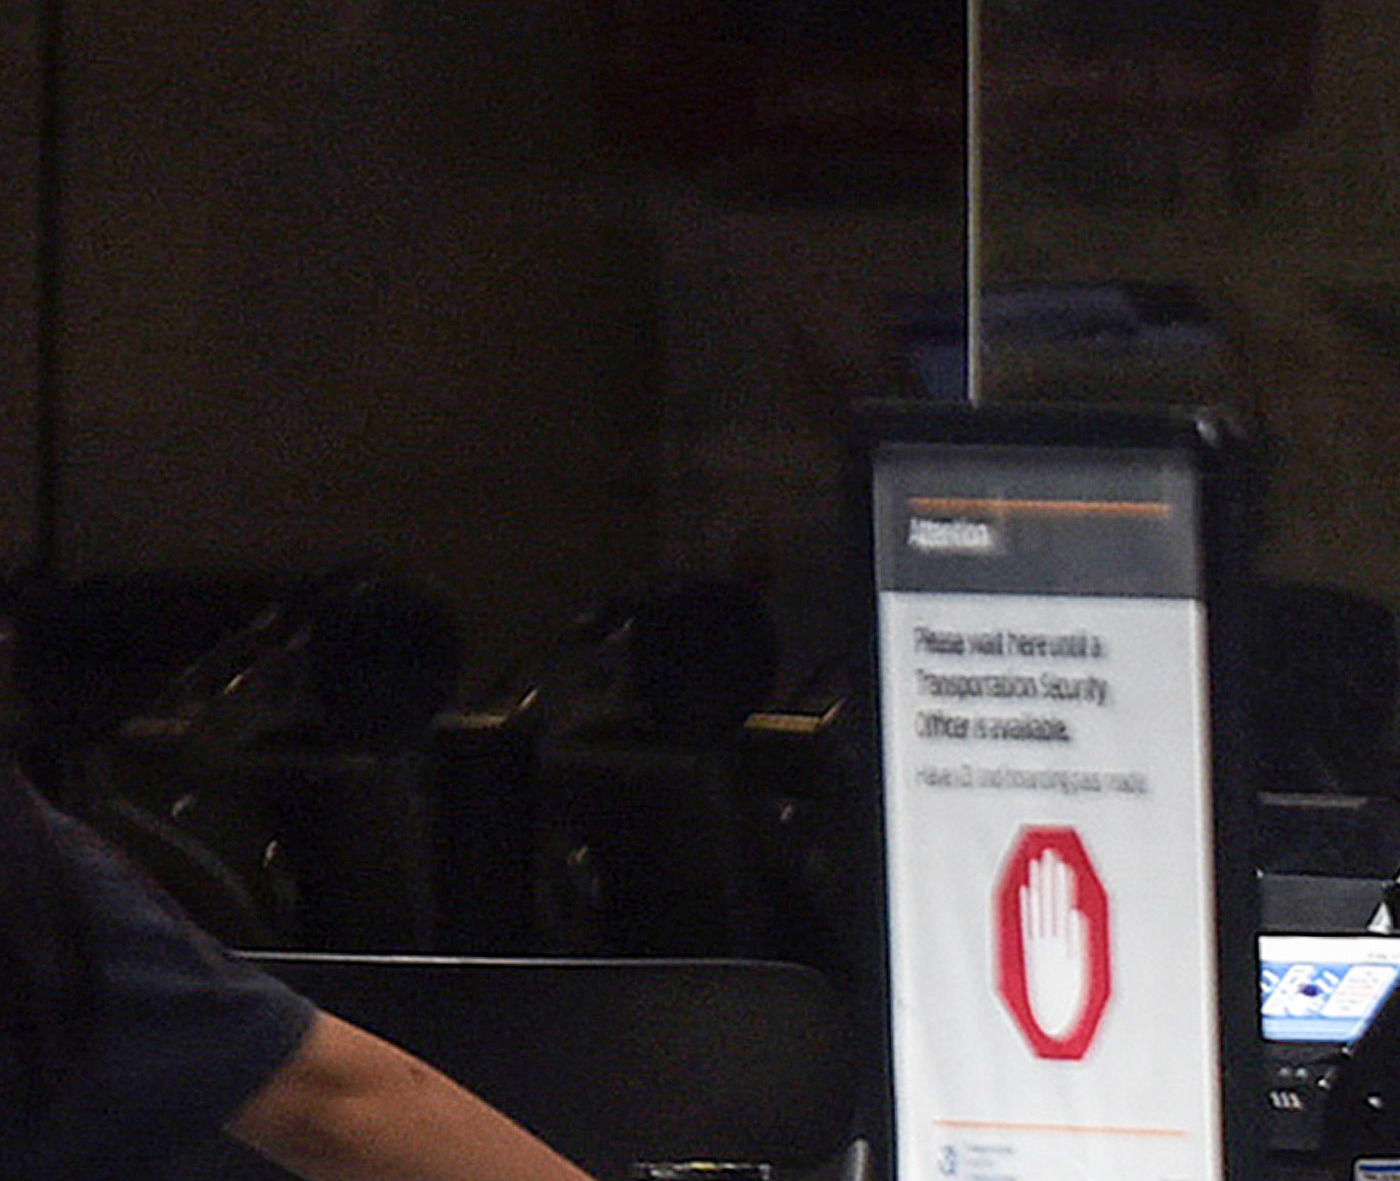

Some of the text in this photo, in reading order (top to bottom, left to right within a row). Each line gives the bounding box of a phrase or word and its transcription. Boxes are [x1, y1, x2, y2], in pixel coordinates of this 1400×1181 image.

[915, 627, 964, 655] Please
[967, 631, 1003, 656] wait
[1007, 631, 1047, 656] here
[1050, 632, 1087, 658] until
[916, 667, 1107, 706] Transportation Security
[915, 710, 969, 739] Officer
